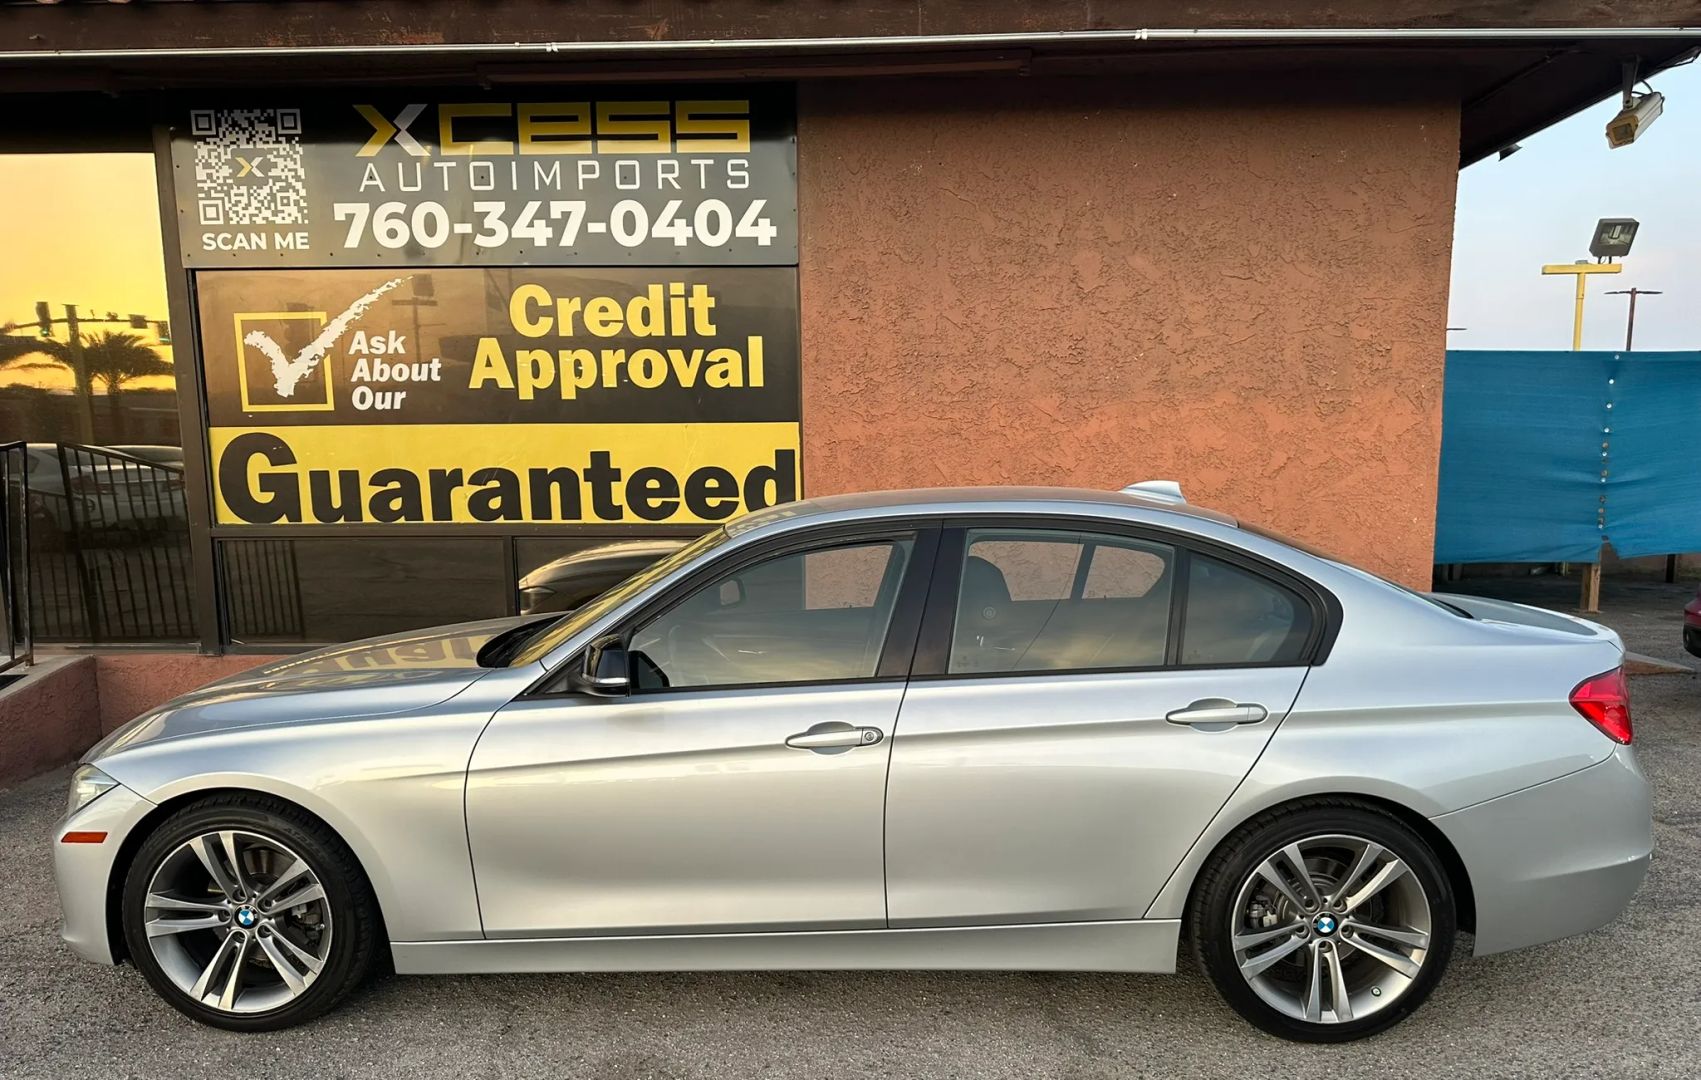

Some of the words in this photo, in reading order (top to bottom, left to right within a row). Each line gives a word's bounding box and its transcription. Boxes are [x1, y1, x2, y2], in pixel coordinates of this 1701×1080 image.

[359, 158, 751, 193] AUTOIMPORTS
[202, 232, 268, 251] SCAN
[273, 231, 310, 250] ME
[333, 199, 778, 250] 760-347-0404
[509, 282, 716, 337] Credit
[348, 330, 406, 356] Ask
[351, 357, 442, 383] About
[468, 335, 764, 400] Approval
[351, 385, 407, 411] Our
[218, 432, 796, 523] Guaranteed
